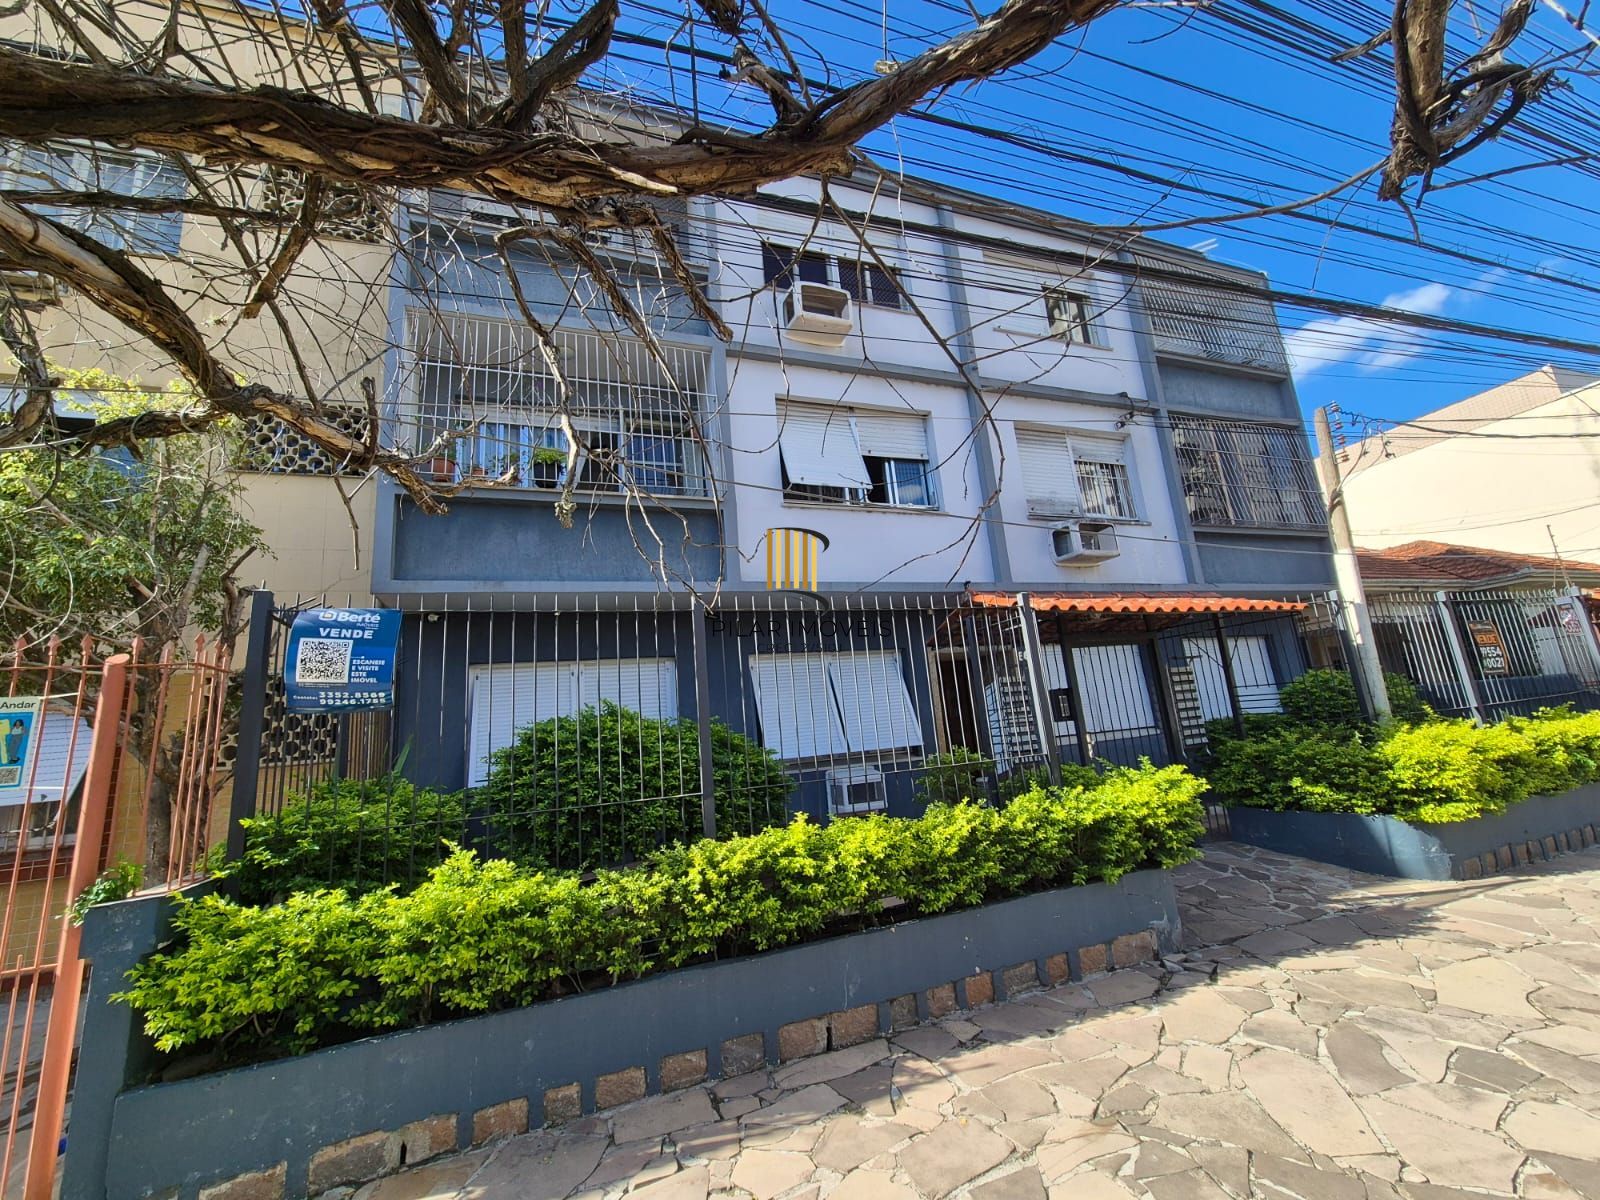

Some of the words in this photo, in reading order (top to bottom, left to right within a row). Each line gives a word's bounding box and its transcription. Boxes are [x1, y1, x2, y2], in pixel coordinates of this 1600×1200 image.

[337, 611, 380, 623] Berté
[319, 627, 374, 639] VENDE
[0, 700, 36, 709] Andar
